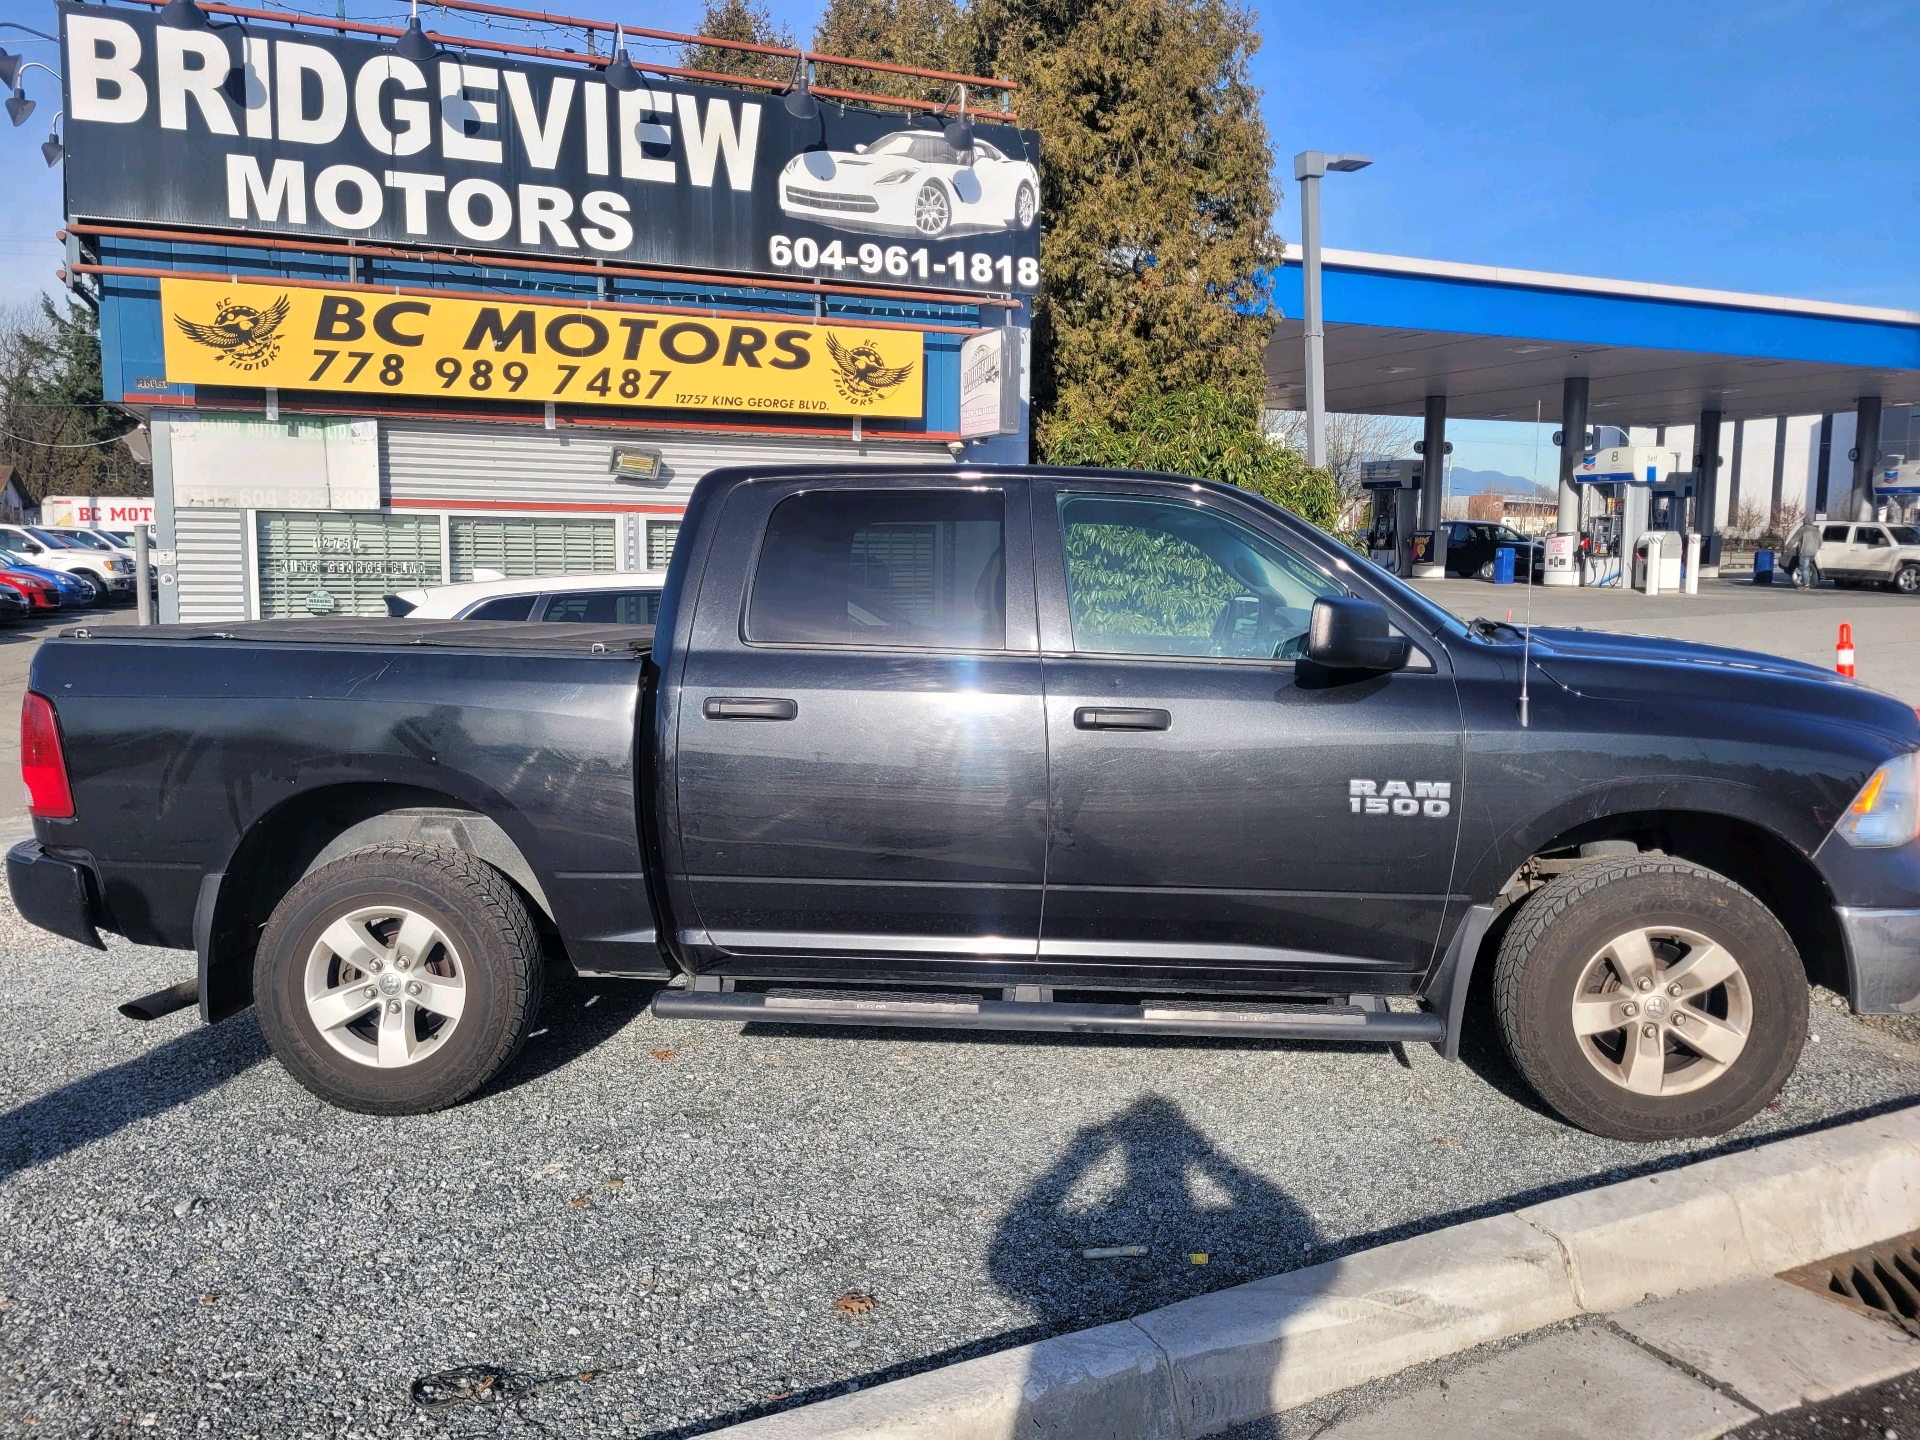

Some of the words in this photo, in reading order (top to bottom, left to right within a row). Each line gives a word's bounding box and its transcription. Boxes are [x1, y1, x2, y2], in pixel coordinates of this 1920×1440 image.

[66, 14, 762, 192] BRIDGEVIEW
[226, 154, 633, 252] MOTORS
[769, 235, 1040, 286] 604-961-1818
[215, 297, 232, 311] BC
[313, 295, 431, 347] BC
[462, 307, 813, 370] MOTORS
[863, 339, 878, 349] BC
[229, 343, 281, 371] MOTORS
[308, 349, 405, 387] 778
[435, 357, 529, 392] 989
[552, 364, 672, 400] 7487
[675, 393, 708, 404] 12757
[712, 395, 744, 406] KING
[747, 397, 795, 409] GEORGE
[798, 400, 830, 411] BLVD.
[834, 379, 874, 406] MOTORS
[247, 419, 280, 438] AUTO
[286, 421, 322, 440] SALES
[326, 422, 350, 441] LTD.
[1611, 451, 1619, 462] 8
[1646, 454, 1658, 462] Self
[78, 507, 102, 521] BC
[110, 507, 155, 521] MOT
[314, 537, 359, 548] 12757
[281, 561, 317, 573] KING
[328, 561, 380, 573] GEORGE
[392, 562, 425, 573] BLVD
[1349, 779, 1451, 798] RAM
[1349, 797, 1450, 817] 1500
